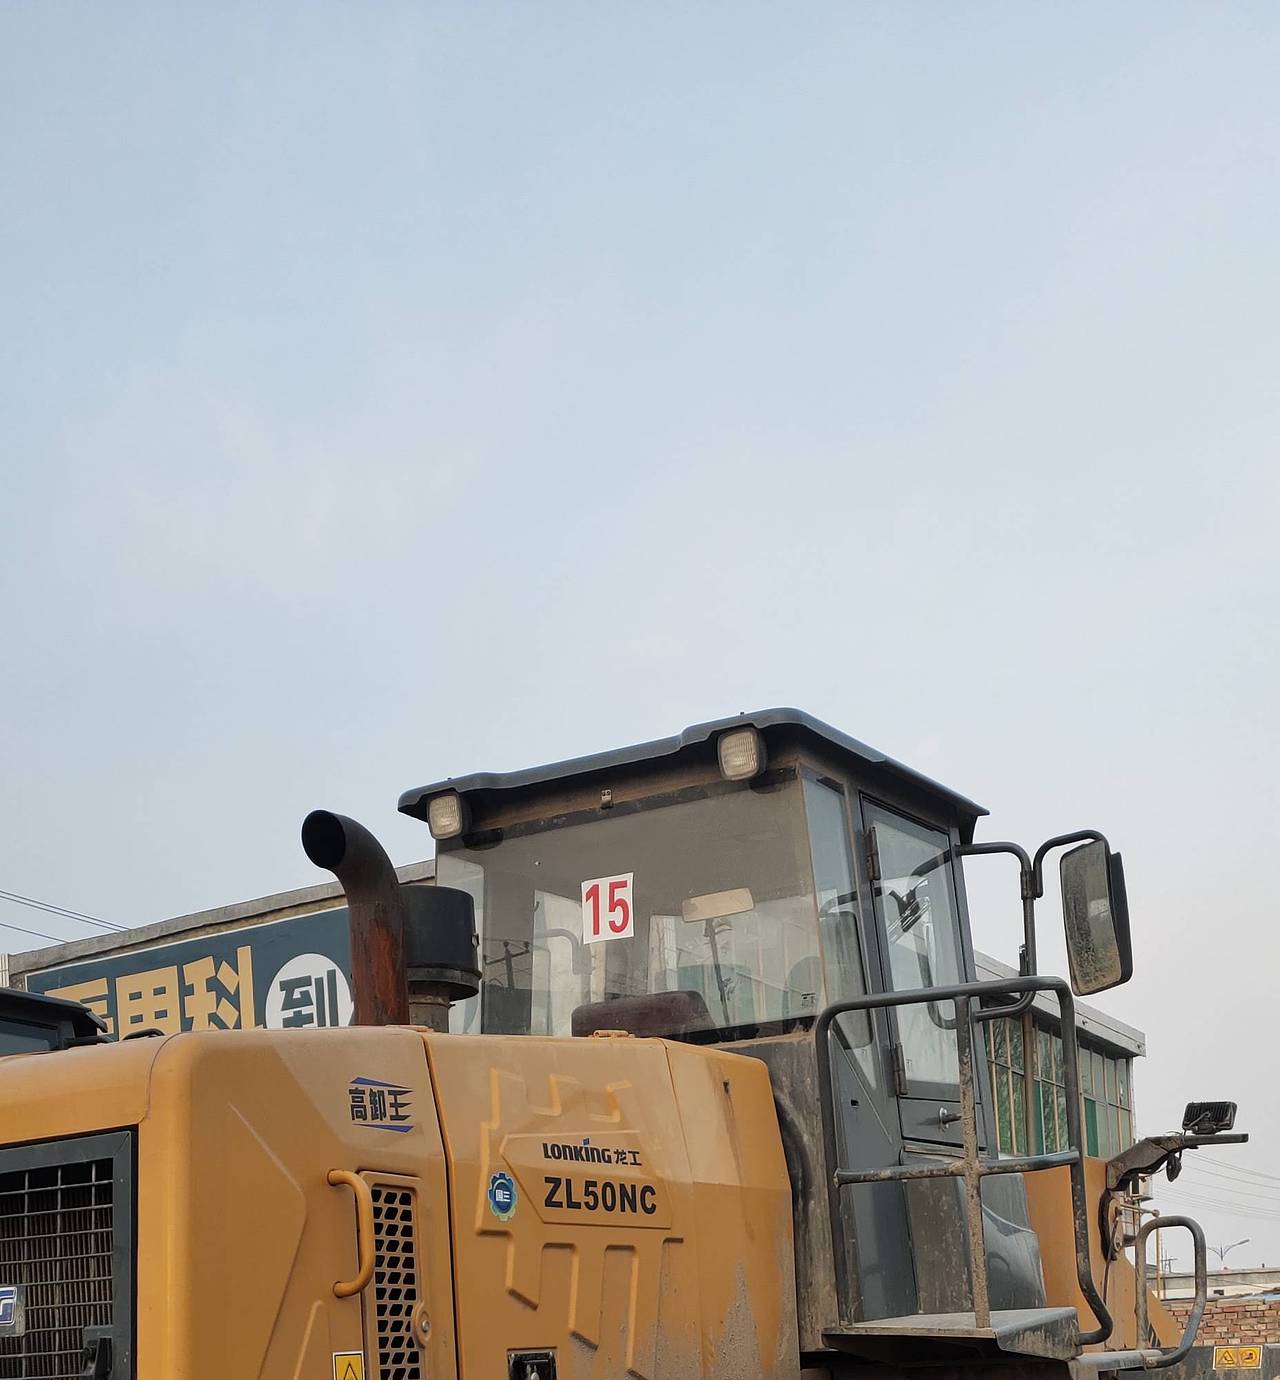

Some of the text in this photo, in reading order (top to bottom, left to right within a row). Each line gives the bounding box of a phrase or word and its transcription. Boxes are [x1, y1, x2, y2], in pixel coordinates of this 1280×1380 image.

[585, 880, 630, 936] 15
[348, 1087, 413, 1122] 高卸王
[613, 1148, 643, 1167] 龙工
[544, 1176, 657, 1215] ZL50NC
